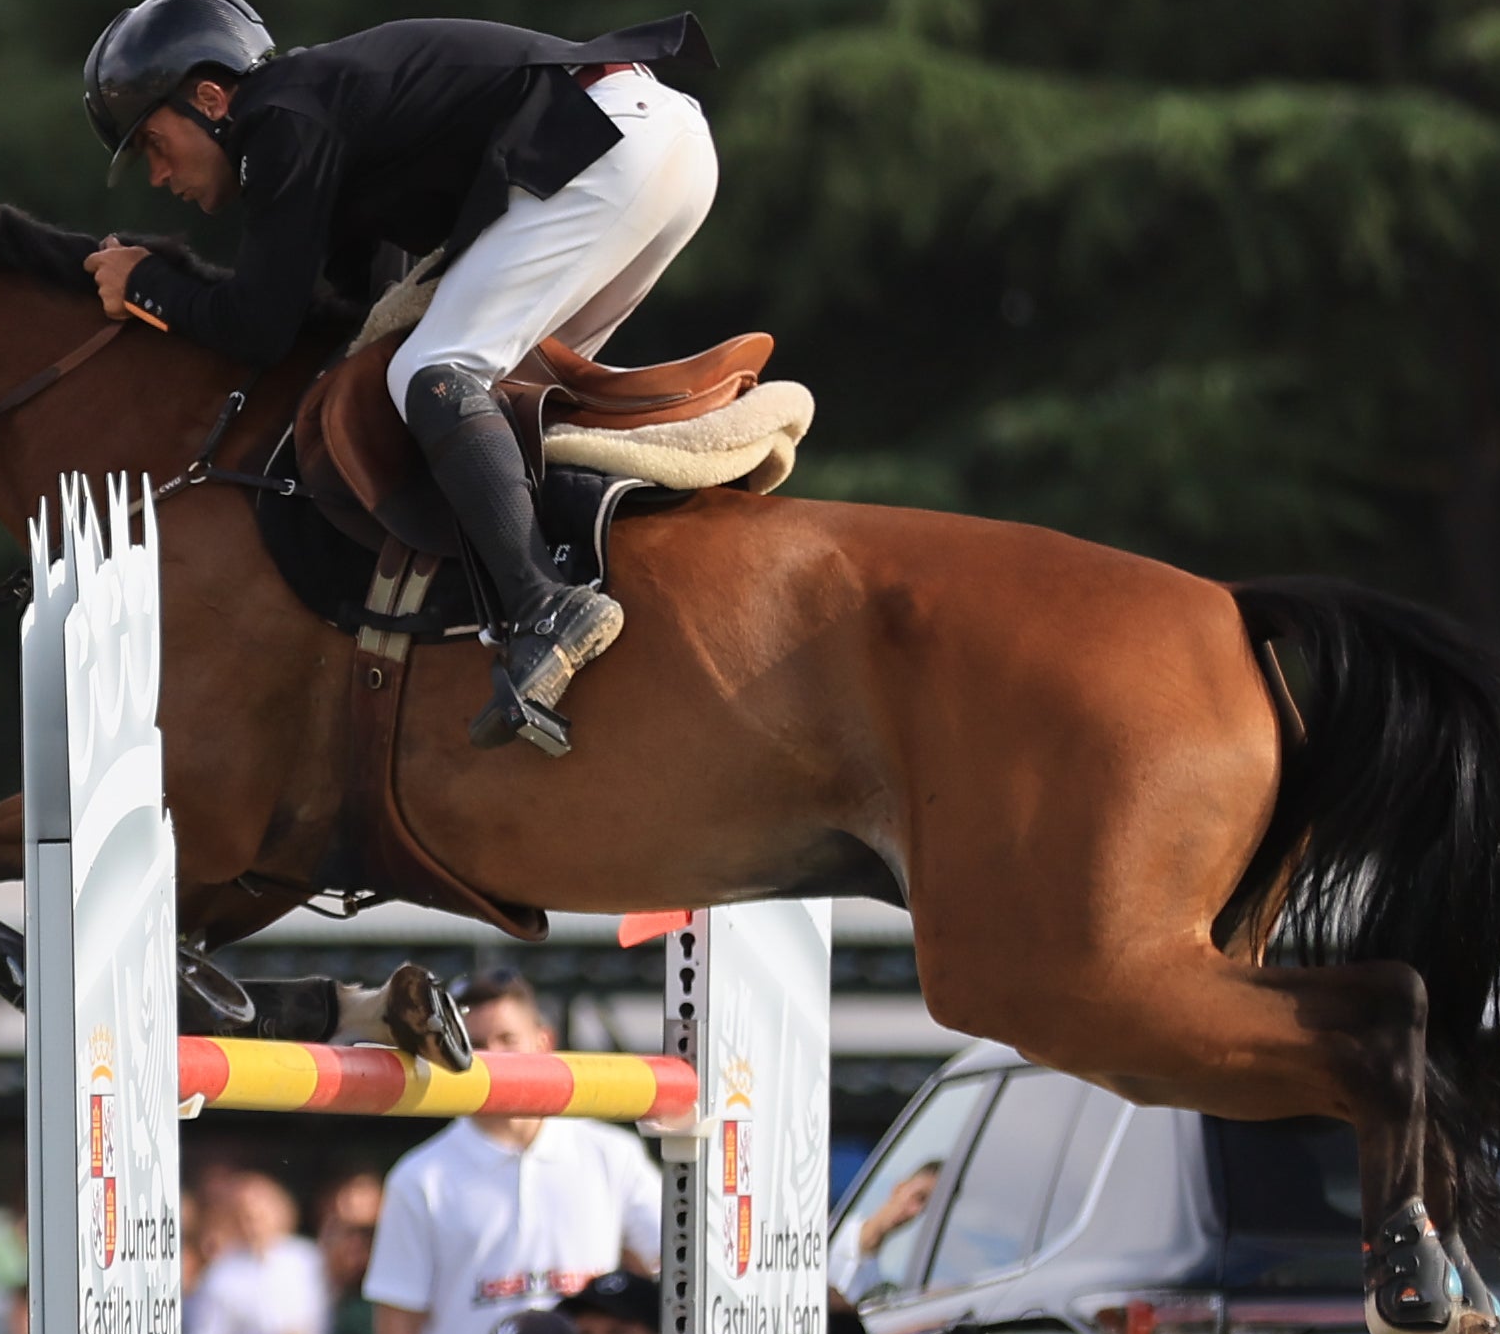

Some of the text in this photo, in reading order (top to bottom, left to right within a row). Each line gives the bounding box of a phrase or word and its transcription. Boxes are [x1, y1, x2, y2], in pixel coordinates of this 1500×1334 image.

[120, 1204, 176, 1263] Junta de
[755, 1218, 822, 1274] Junta de
